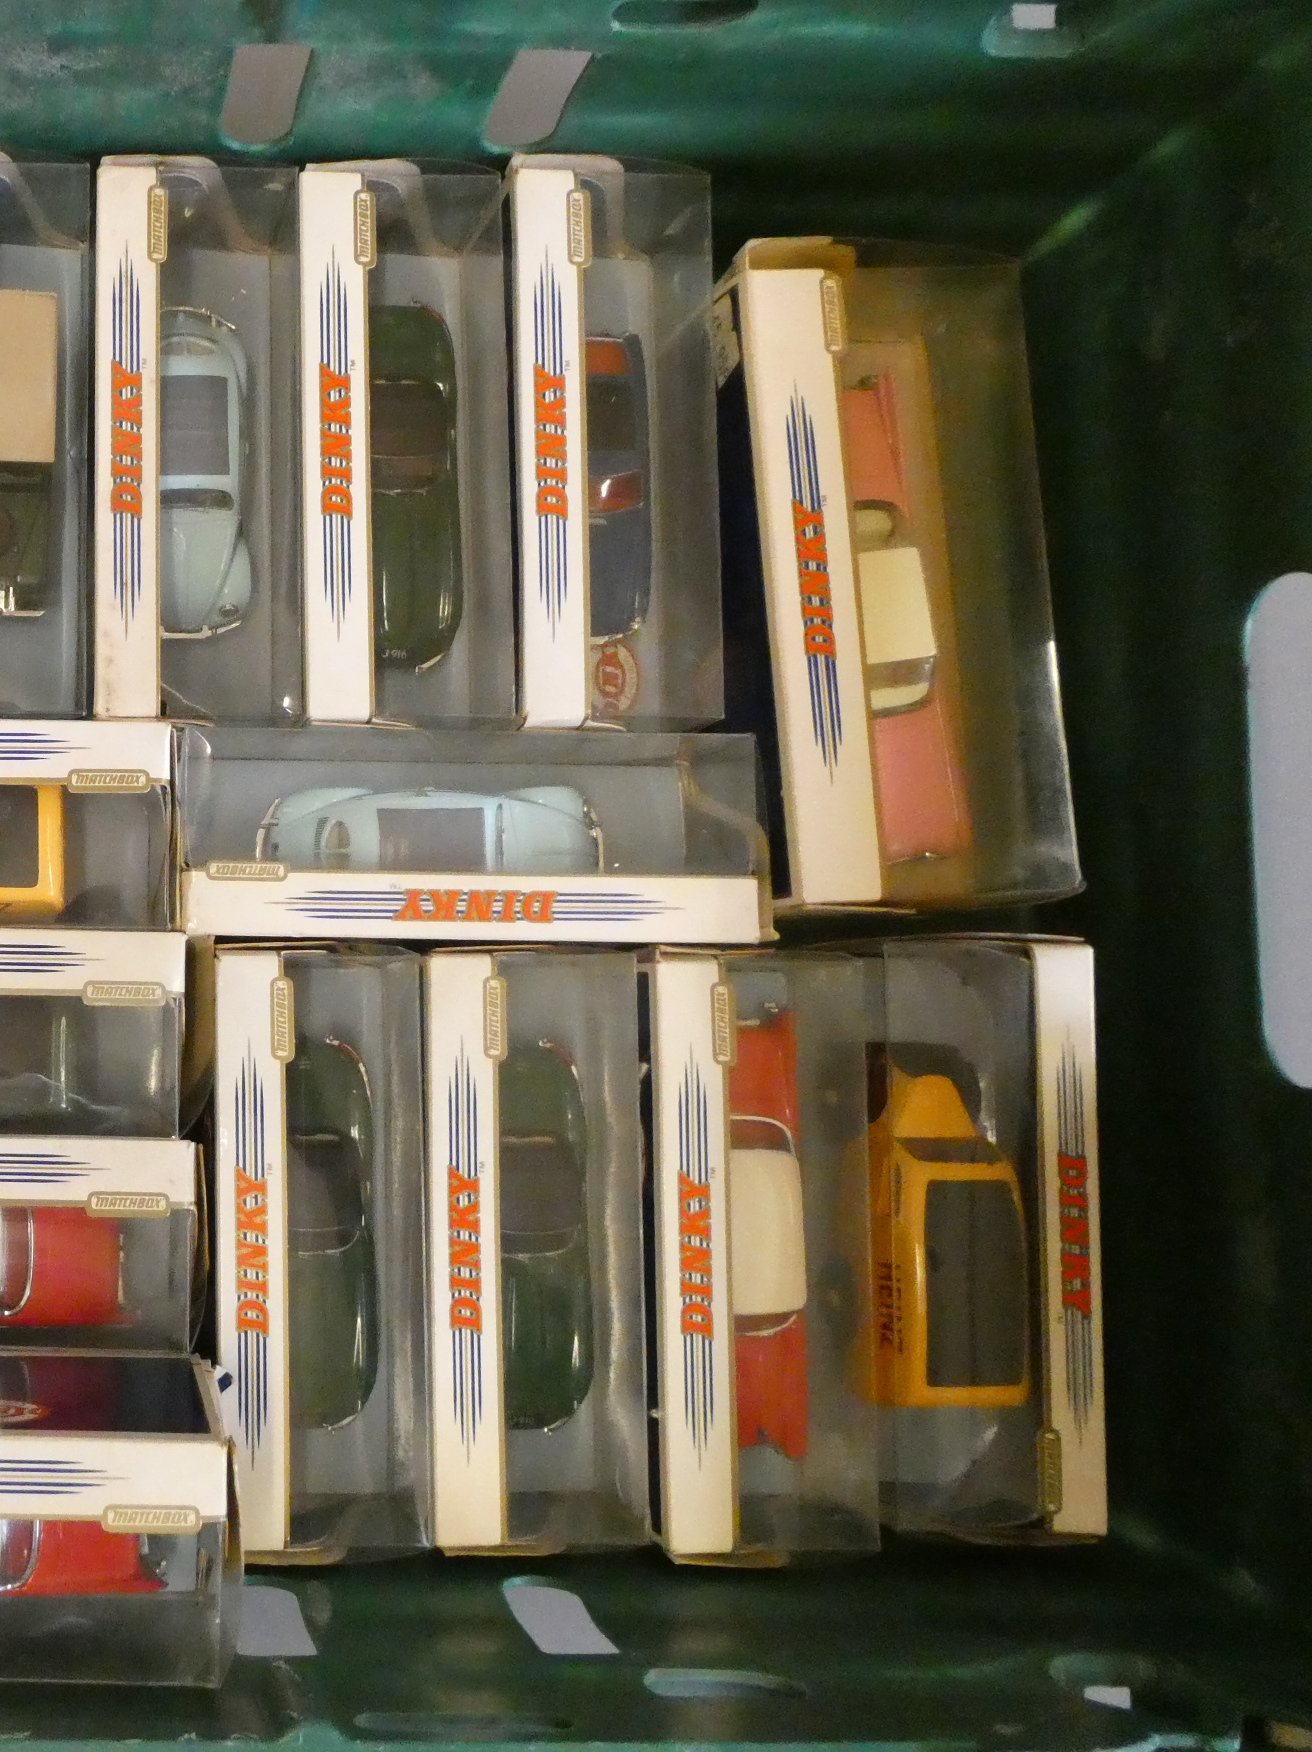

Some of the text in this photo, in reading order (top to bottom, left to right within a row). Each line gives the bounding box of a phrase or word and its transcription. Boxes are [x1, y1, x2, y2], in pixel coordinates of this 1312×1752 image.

[110, 361, 144, 518] DINKY
[318, 362, 354, 519] DINKY
[533, 363, 569, 519] DINKY
[791, 501, 838, 658] DINKY
[393, 889, 557, 923] DINKY
[234, 1167, 270, 1336] DINKY
[447, 1165, 483, 1333] DINKY
[677, 1172, 715, 1340] DINKY
[1058, 1154, 1091, 1317] DINKY
